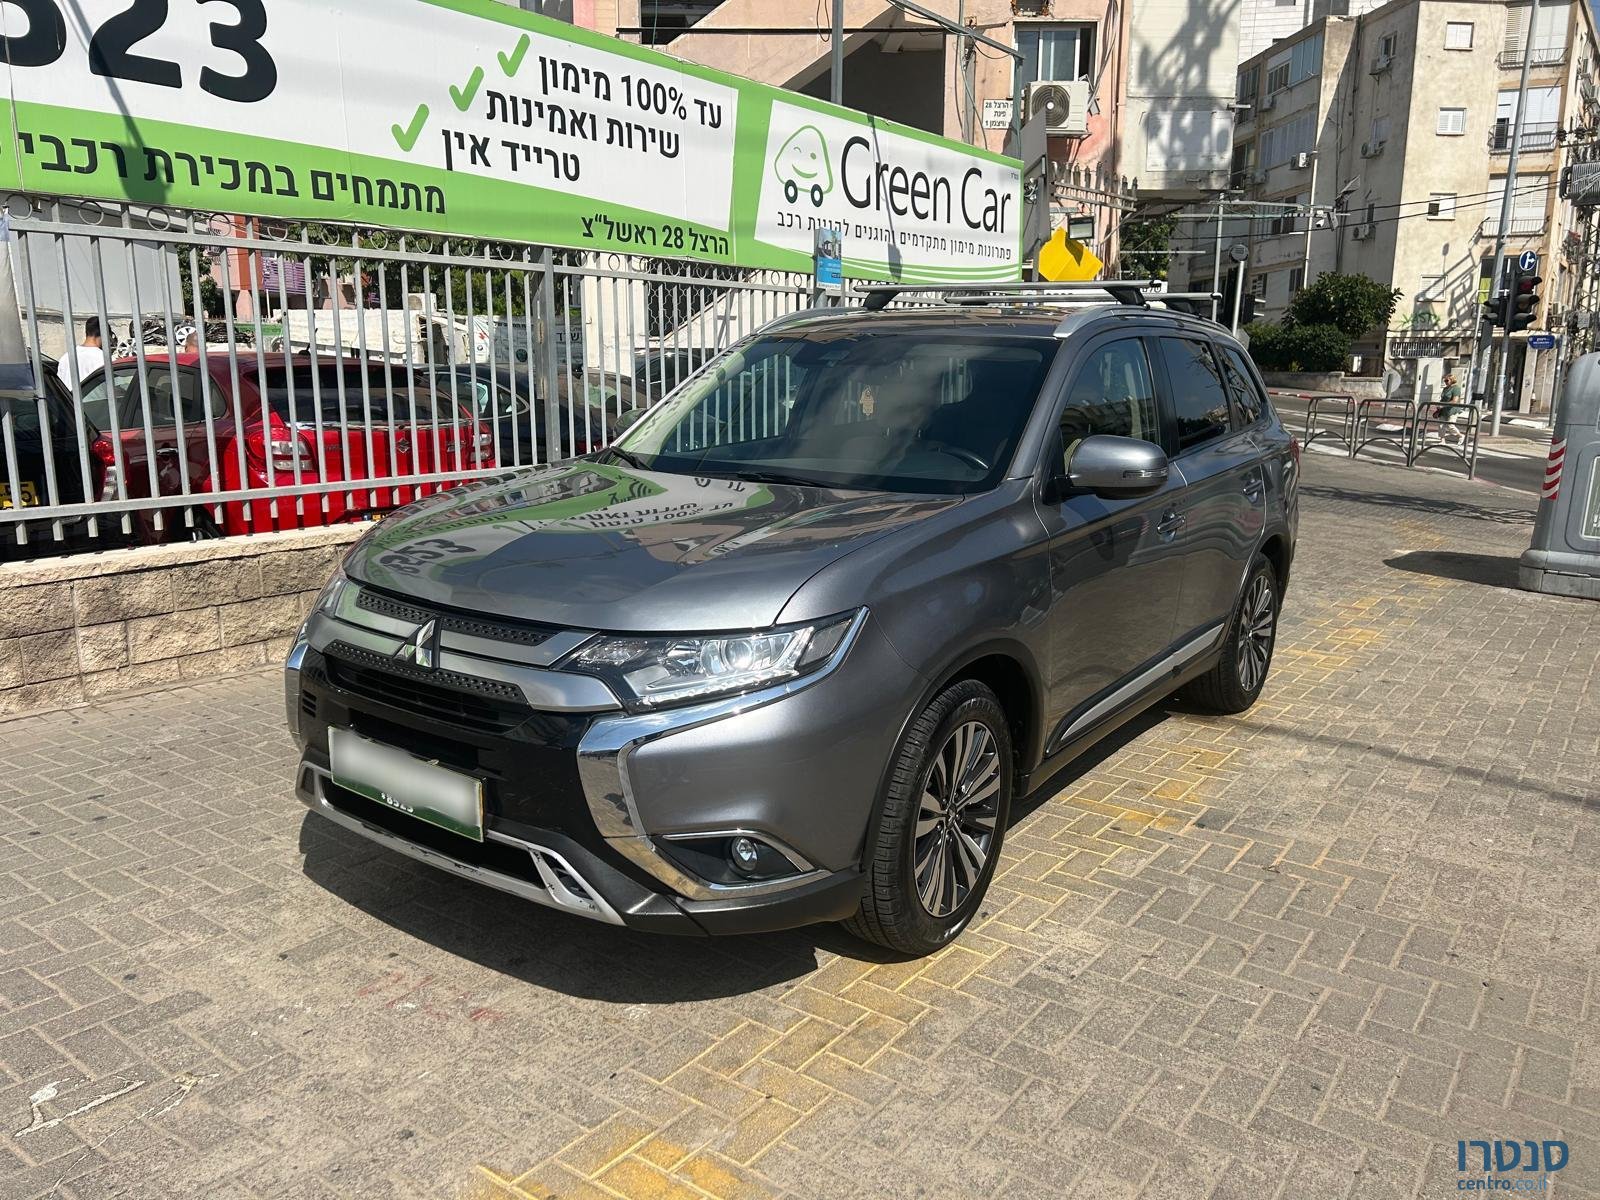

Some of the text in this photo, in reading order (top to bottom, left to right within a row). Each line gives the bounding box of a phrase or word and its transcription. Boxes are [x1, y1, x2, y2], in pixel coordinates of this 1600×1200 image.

[539, 56, 722, 129] עד 100% מימון
[486, 89, 680, 159] שירות ואמינות
[442, 129, 580, 182] טרייד אין
[18, 131, 446, 214] מתמחים במכירת רכבי
[841, 136, 1011, 234] Green Car
[777, 211, 802, 230] רכב
[662, 224, 684, 249] 28
[689, 227, 729, 255] הרצל
[900, 231, 947, 252] מתקדמים
[951, 239, 975, 255] מימון
[977, 244, 1012, 260] פתרונות
